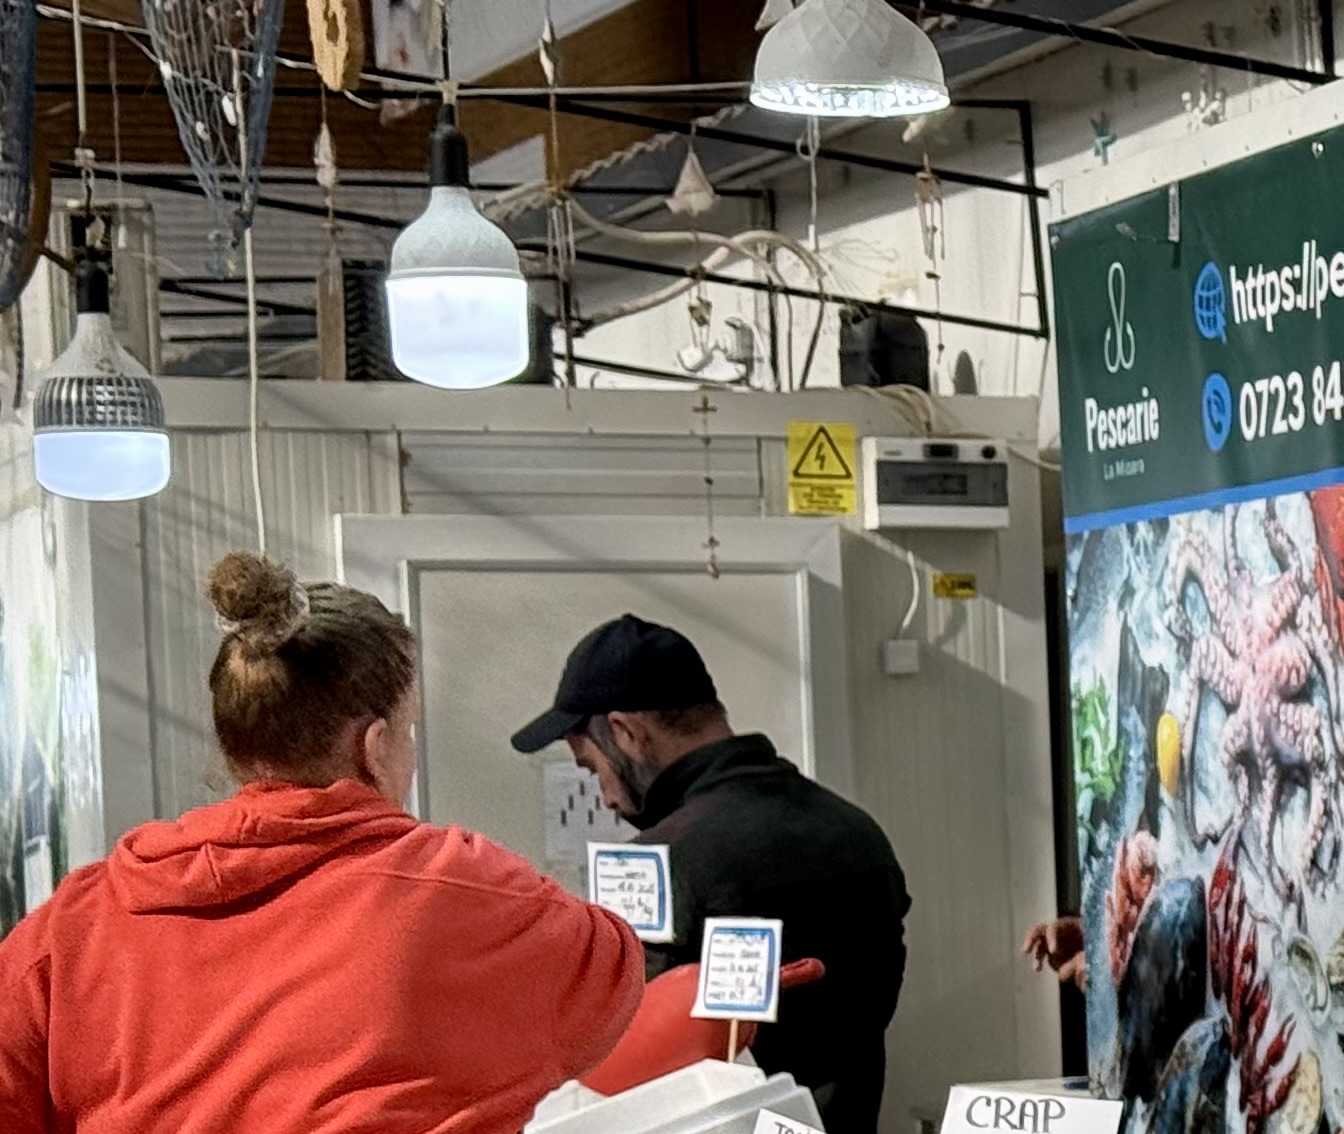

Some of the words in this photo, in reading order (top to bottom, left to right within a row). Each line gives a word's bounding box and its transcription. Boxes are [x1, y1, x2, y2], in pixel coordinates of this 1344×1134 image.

[1084, 386, 1160, 454] Pescarie
[1239, 370, 1306, 442] 0723
[966, 1095, 1066, 1134] CRAP
